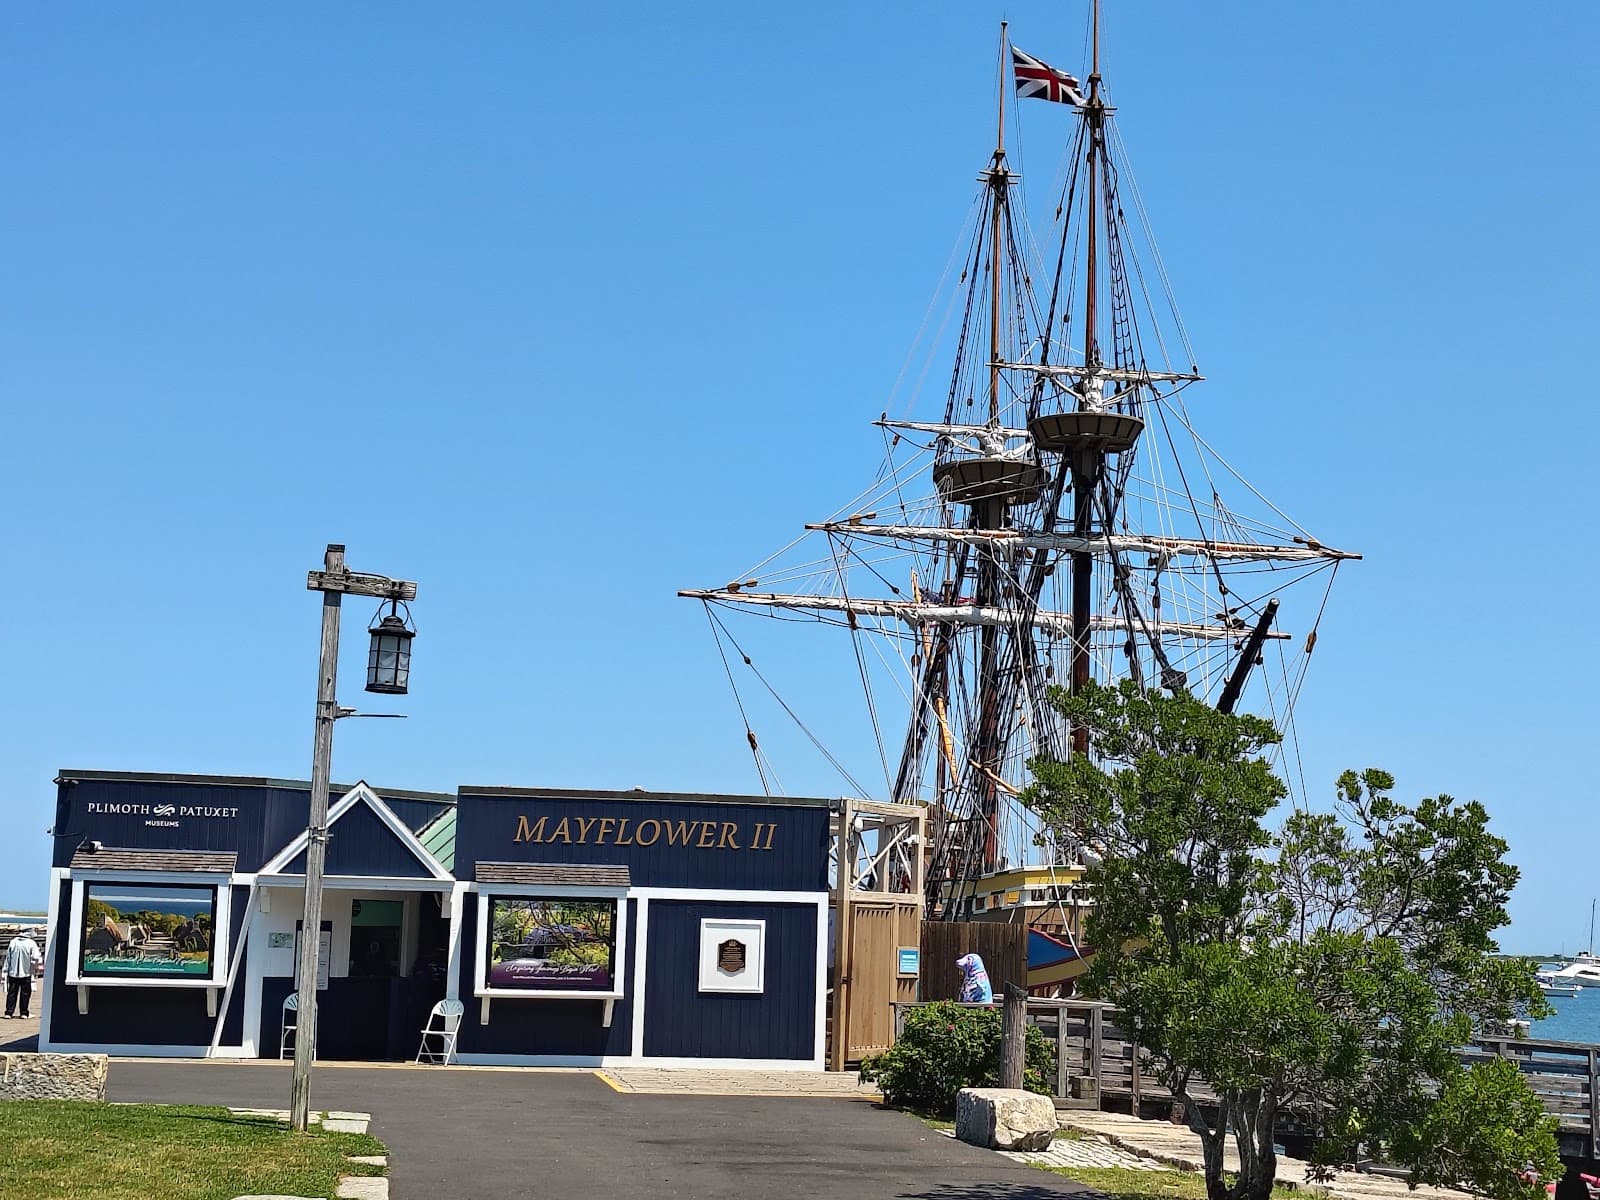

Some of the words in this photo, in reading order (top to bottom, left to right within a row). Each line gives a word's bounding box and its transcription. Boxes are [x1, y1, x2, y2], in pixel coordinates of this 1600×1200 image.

[88, 802, 150, 815] PLIMOTH
[179, 806, 239, 817] PATUXET
[145, 820, 180, 828] MUSEUMS
[513, 815, 741, 850] MAYFLOWER
[749, 823, 778, 850] II
